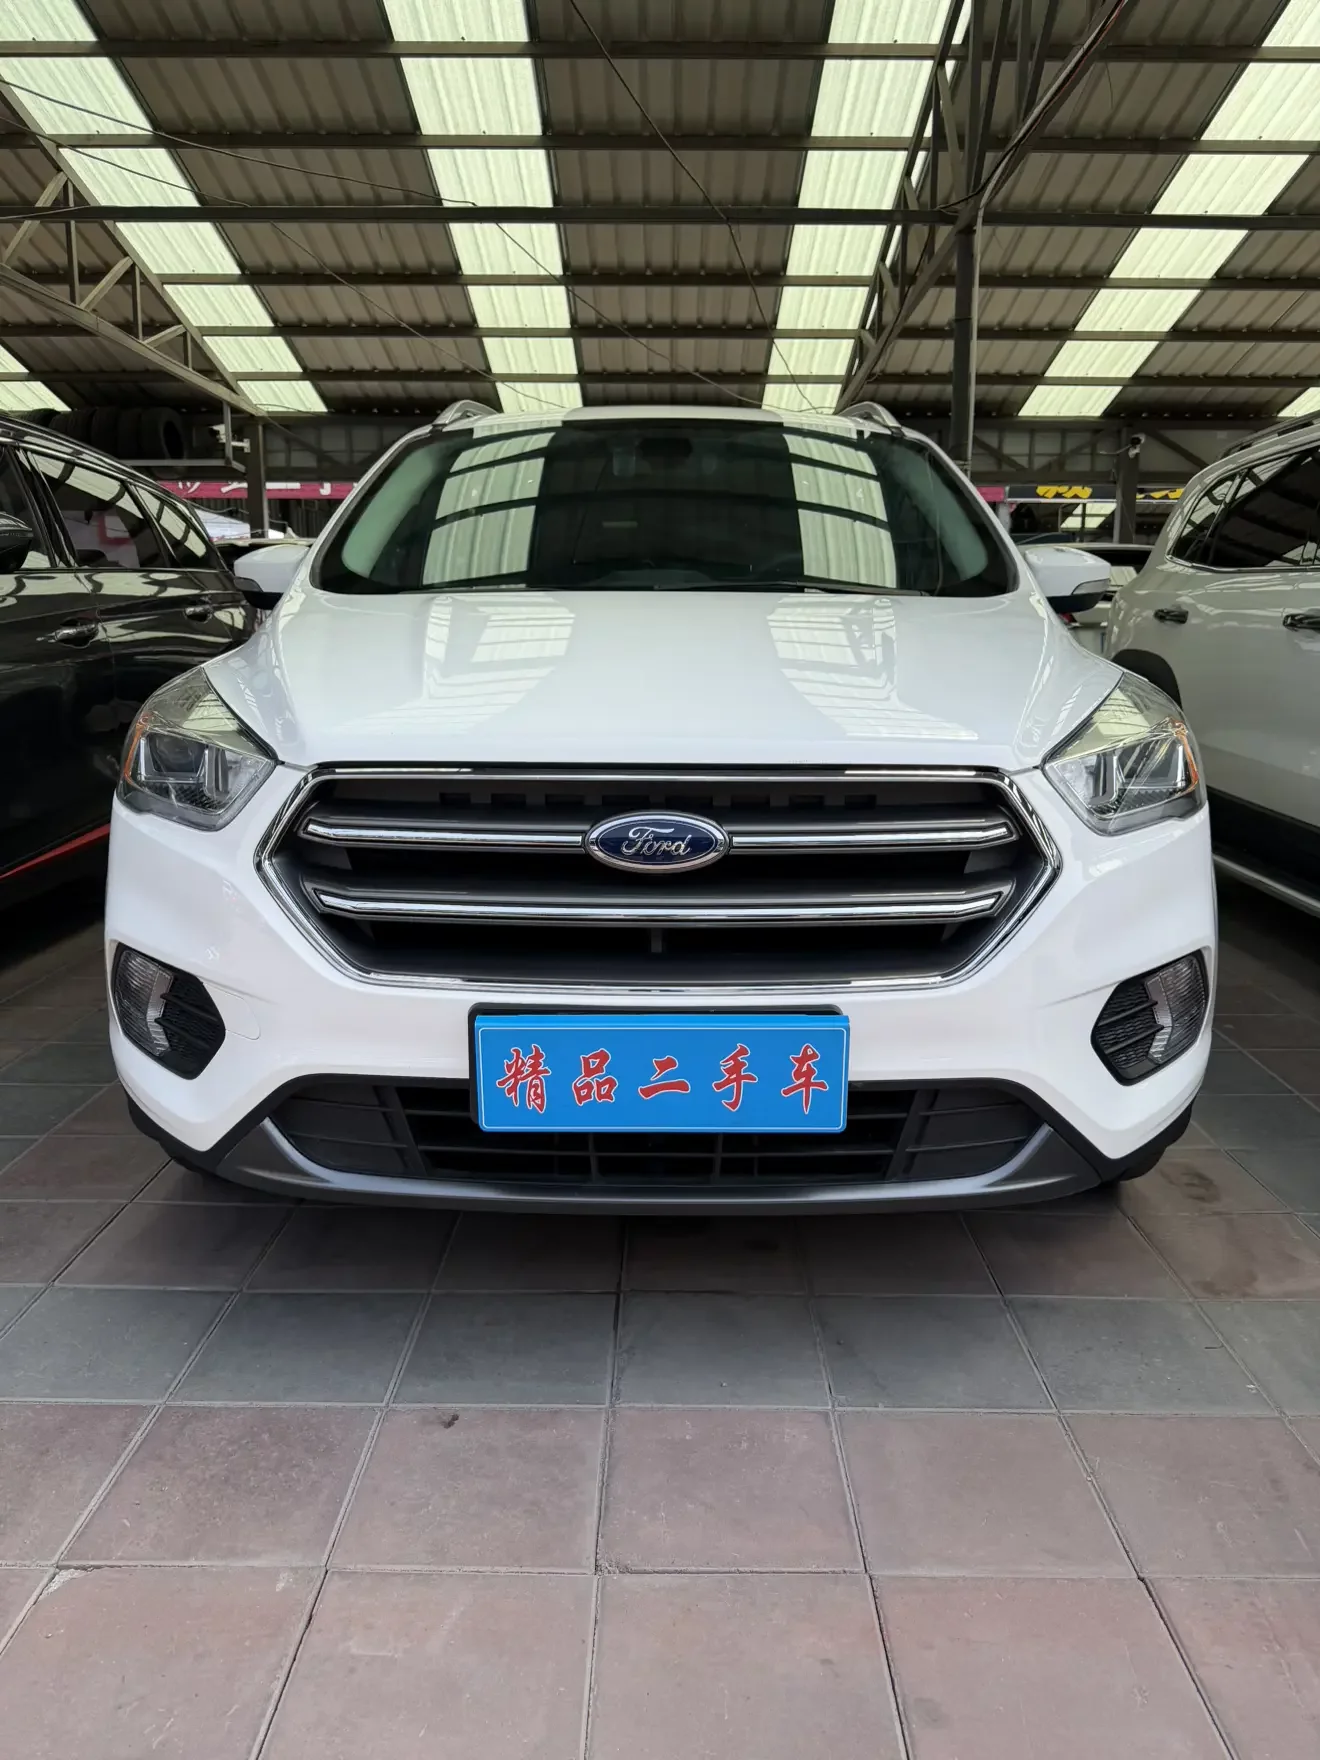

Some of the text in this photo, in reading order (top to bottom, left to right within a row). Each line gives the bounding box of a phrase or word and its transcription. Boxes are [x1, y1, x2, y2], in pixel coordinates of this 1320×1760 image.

[621, 826, 692, 856] Ford
[496, 1043, 829, 1114] 精品二手车
